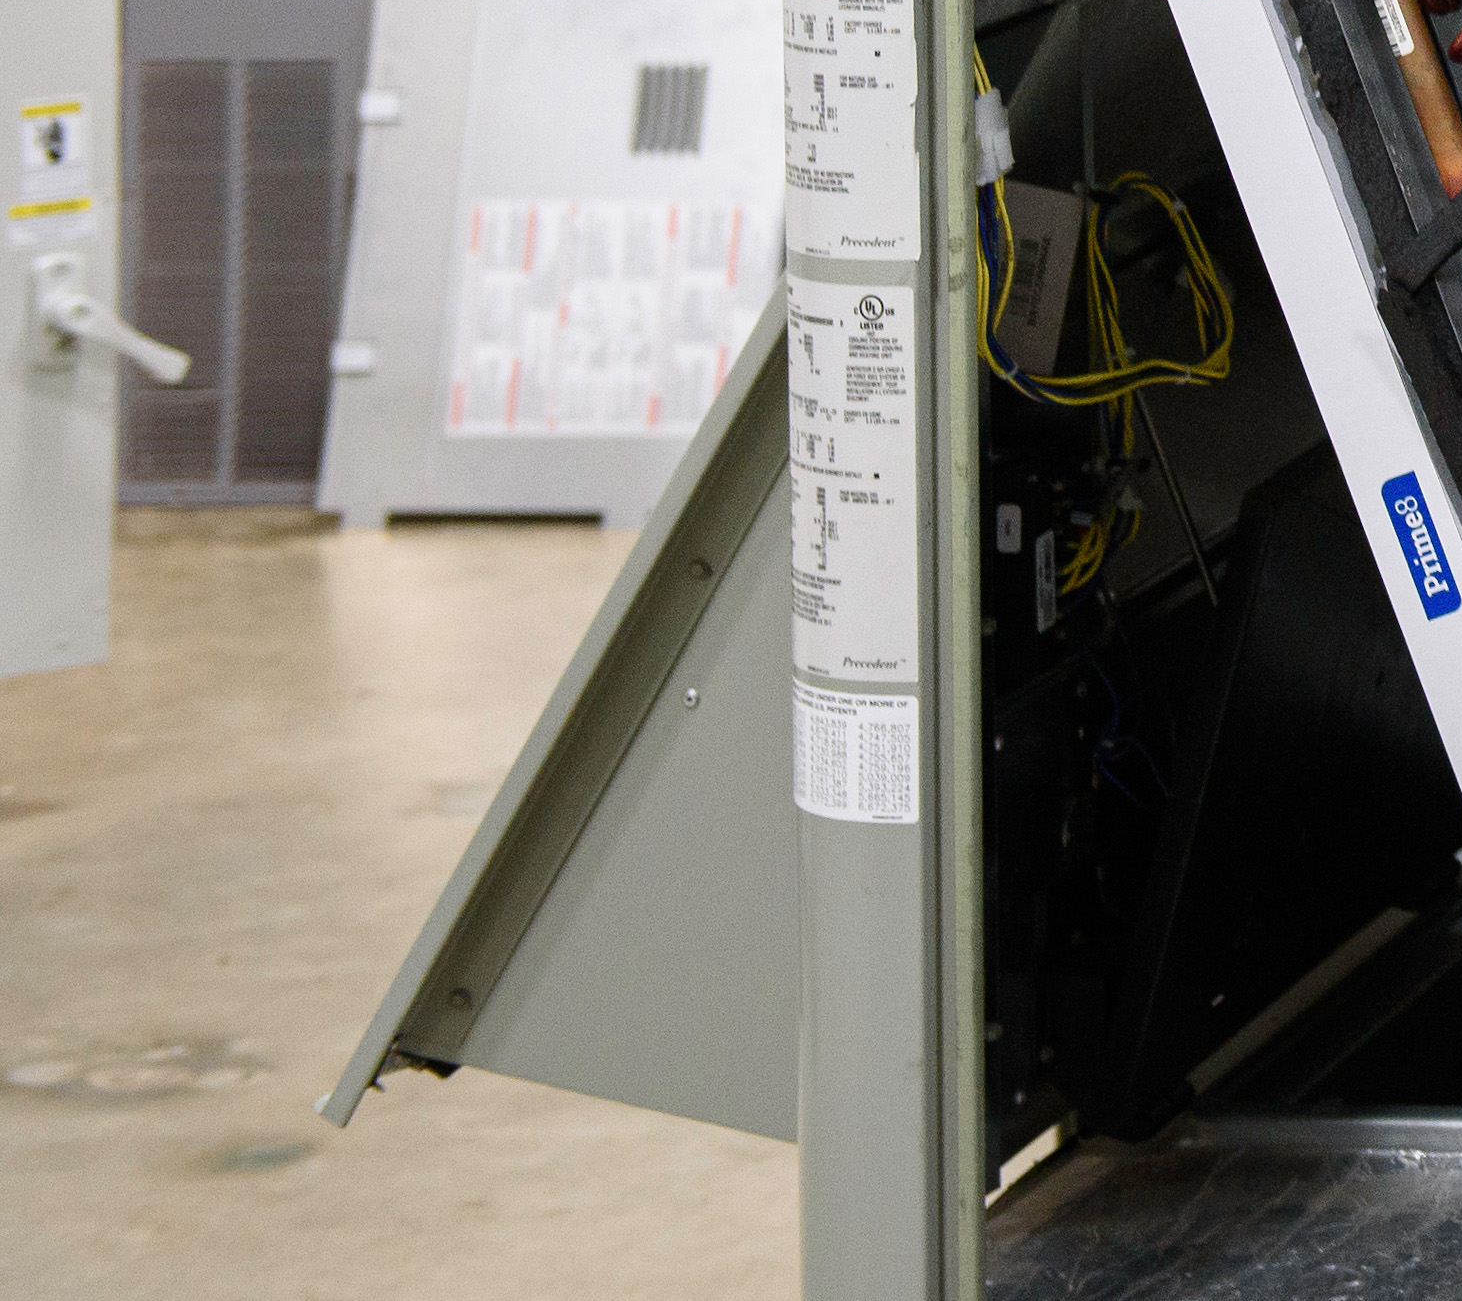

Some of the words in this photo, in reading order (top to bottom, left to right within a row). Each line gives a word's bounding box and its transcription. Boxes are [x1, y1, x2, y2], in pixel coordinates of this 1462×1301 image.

[840, 235, 896, 248] Precedent
[860, 322, 884, 330] LISTED
[1394, 495, 1450, 598] Prime8
[826, 705, 857, 716] PATENTS
